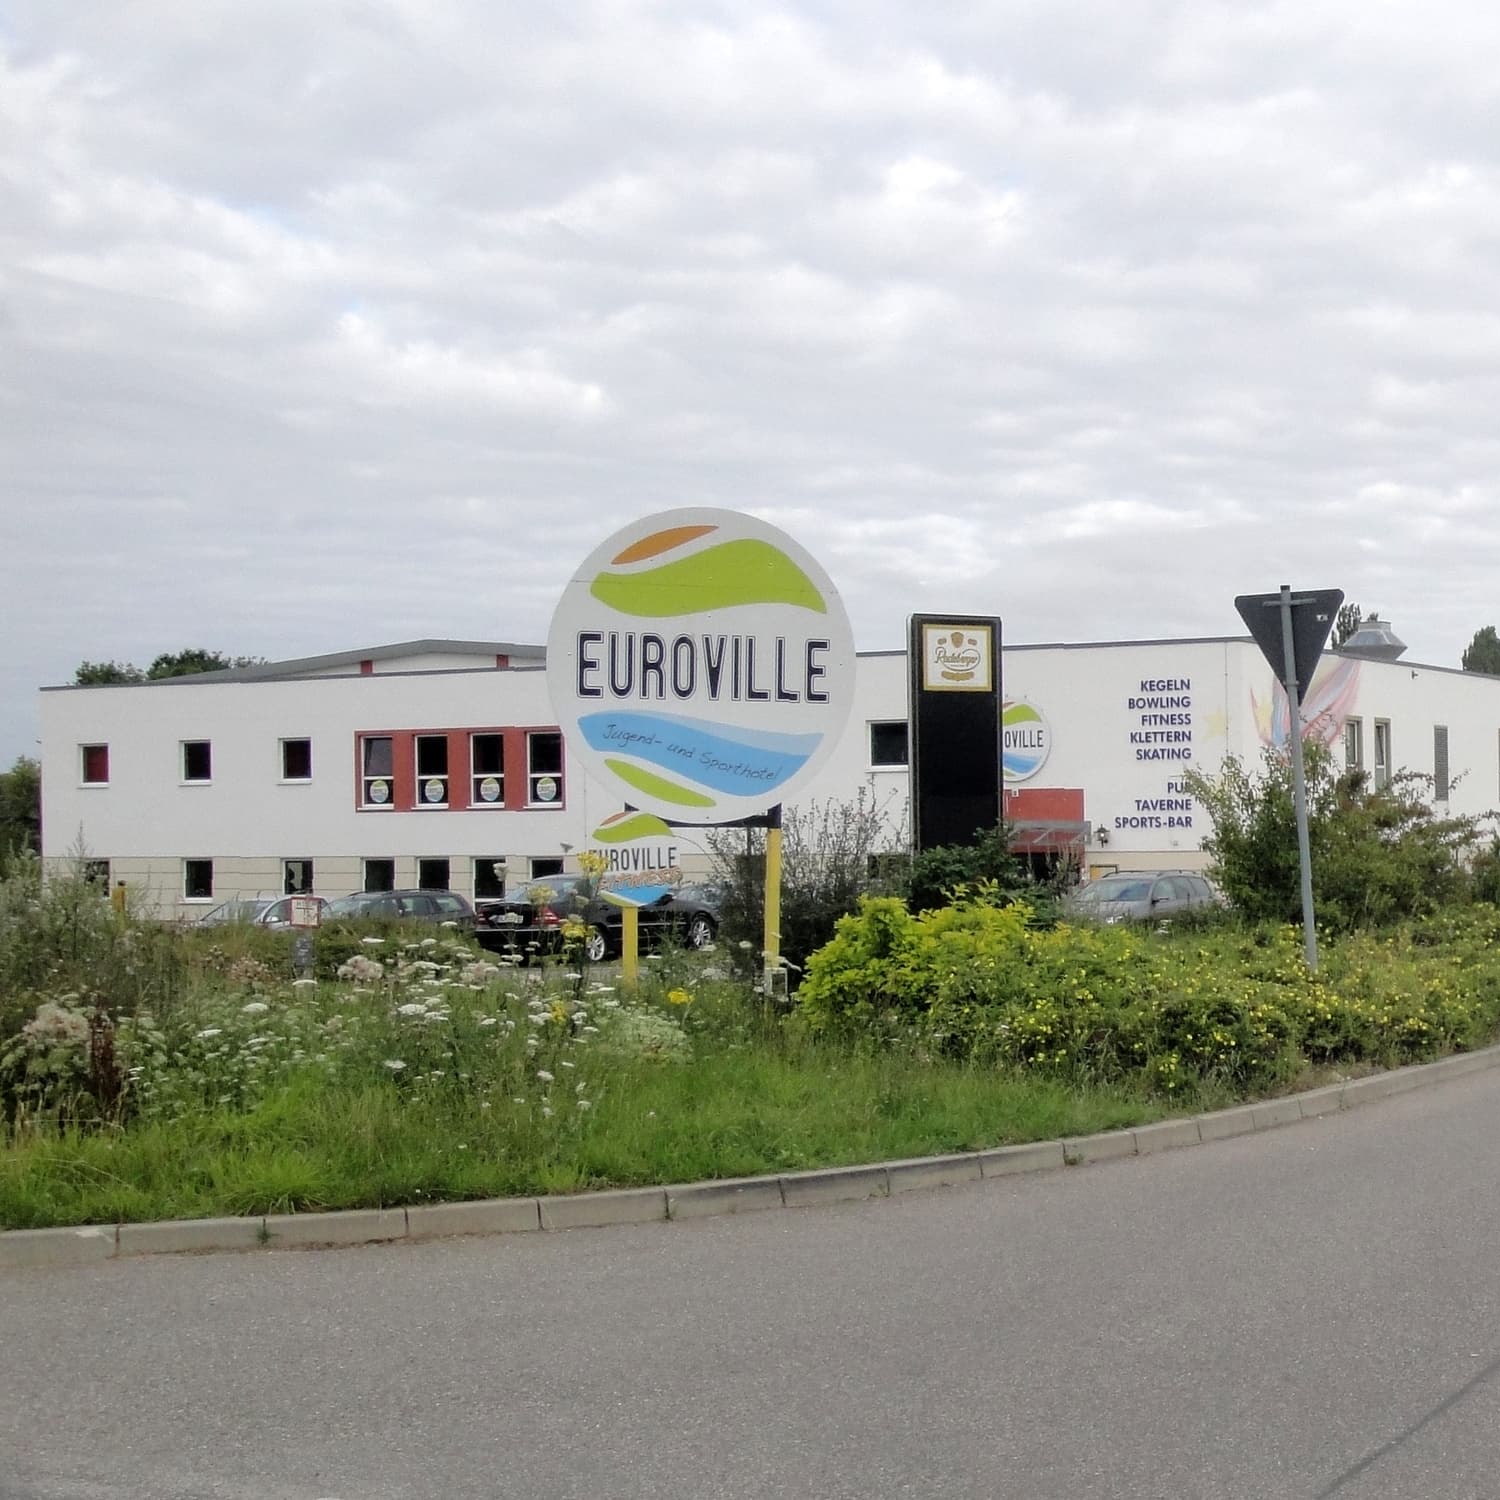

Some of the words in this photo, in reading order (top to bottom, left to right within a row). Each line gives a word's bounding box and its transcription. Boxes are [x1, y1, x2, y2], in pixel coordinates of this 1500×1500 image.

[576, 630, 830, 704] EUROVILLE
[1140, 678, 1191, 692] KEGELN
[1128, 696, 1191, 710] BOWLING
[1141, 713, 1192, 727] FITNESS
[1004, 729, 1044, 749] OVILLE
[1130, 730, 1192, 744] KLETTERN
[602, 724, 663, 748] Jugend-
[667, 742, 694, 759] und
[699, 751, 782, 781] Sporthotel
[1136, 747, 1192, 761] SKATING
[1167, 781, 1191, 794] PU
[1134, 799, 1193, 811] TAVERNE
[1114, 816, 1193, 829] SPORTS-BAR
[588, 846, 678, 872] ROVILLE
